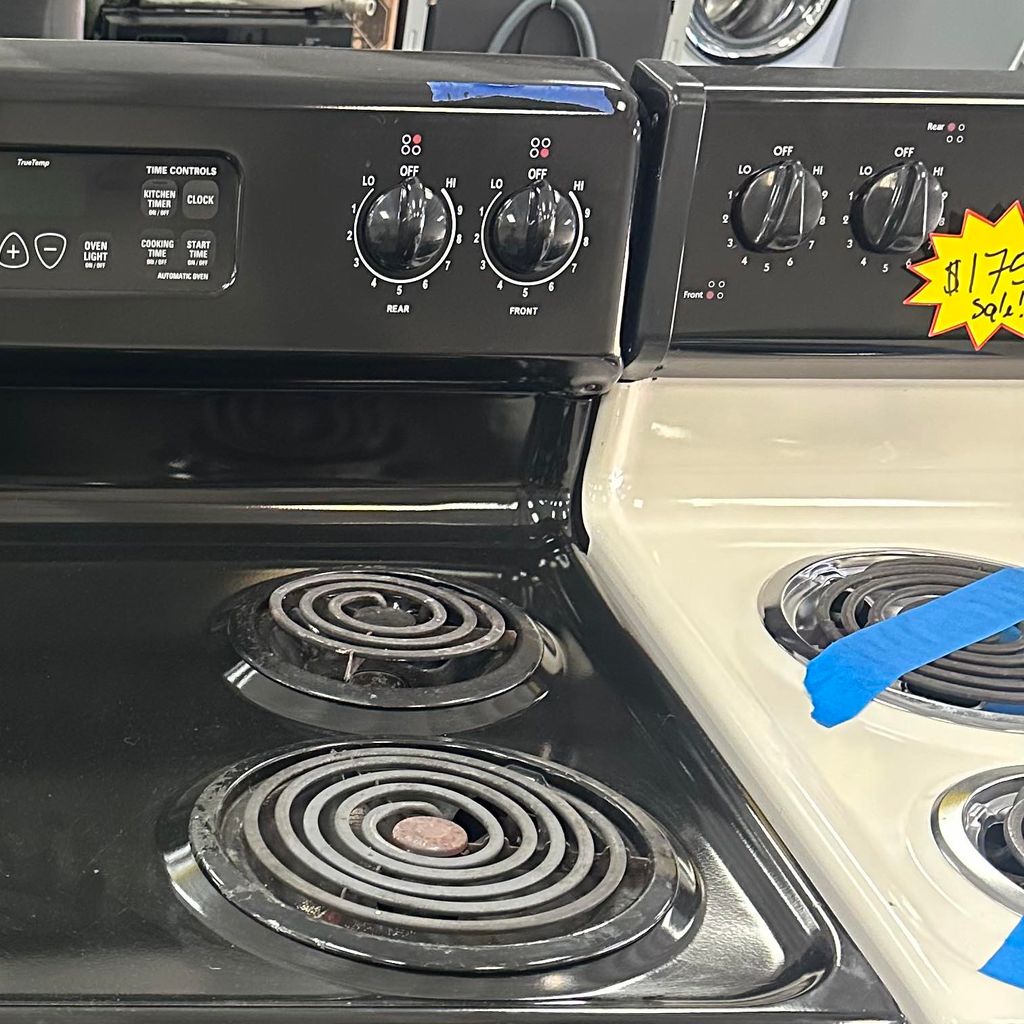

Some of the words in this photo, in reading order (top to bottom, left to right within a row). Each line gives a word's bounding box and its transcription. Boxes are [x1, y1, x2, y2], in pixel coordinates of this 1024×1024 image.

[927, 122, 945, 131] Rear
[773, 146, 794, 157] OFF
[894, 147, 915, 158] OFF
[17, 158, 51, 168] TrueTemp
[146, 166, 167, 175] TIME
[170, 166, 217, 176] CONTROLS
[400, 165, 419, 177] OFF
[528, 168, 548, 180] OFF
[738, 165, 752, 175] LO
[813, 166, 823, 175] HI
[859, 165, 873, 176] LO
[933, 166, 944, 177] HI
[362, 175, 375, 187] LO
[445, 177, 457, 189] HI
[490, 178, 504, 189] LO
[573, 180, 585, 191] HI
[143, 189, 176, 199] KITCHEN
[728, 191, 733, 199] 1
[821, 190, 828, 200] 9
[848, 191, 854, 200] 1
[942, 191, 948, 201] 9
[147, 199, 172, 208] TIMER
[186, 195, 214, 205] CLOCK
[351, 203, 356, 214] 1
[457, 205, 463, 216] 9
[479, 206, 484, 217] 1
[584, 208, 591, 219] 9
[722, 214, 729, 223] 2
[819, 216, 826, 225] 8
[842, 215, 849, 225] 2
[346, 230, 353, 241] 2
[456, 234, 462, 244] 8
[473, 233, 480, 244] 2
[84, 240, 108, 251] OVEN
[141, 239, 174, 248] COOKING
[186, 240, 211, 249] START
[583, 237, 589, 247] 8
[727, 238, 733, 248] 3
[808, 240, 815, 250] 7
[847, 239, 853, 249] 3
[83, 251, 108, 261] LIGHT
[148, 249, 167, 257] TIME
[189, 250, 208, 258] TIME
[353, 257, 359, 268] 3
[445, 260, 451, 271] 7
[480, 260, 486, 270] 3
[741, 256, 748, 265] 4
[787, 257, 794, 267] 6
[860, 257, 867, 267] 4
[571, 263, 577, 273] 7
[764, 262, 770, 272] 5
[882, 263, 889, 273] 5
[157, 272, 192, 280] AUTOMATIC
[370, 277, 377, 288] 4
[422, 279, 428, 290] 6
[497, 280, 503, 290] 4
[548, 282, 554, 292] 6
[396, 285, 403, 296] 5
[522, 288, 529, 298] 5
[683, 291, 704, 299] Front
[386, 304, 410, 313] REAR
[509, 306, 539, 315] FRONT
